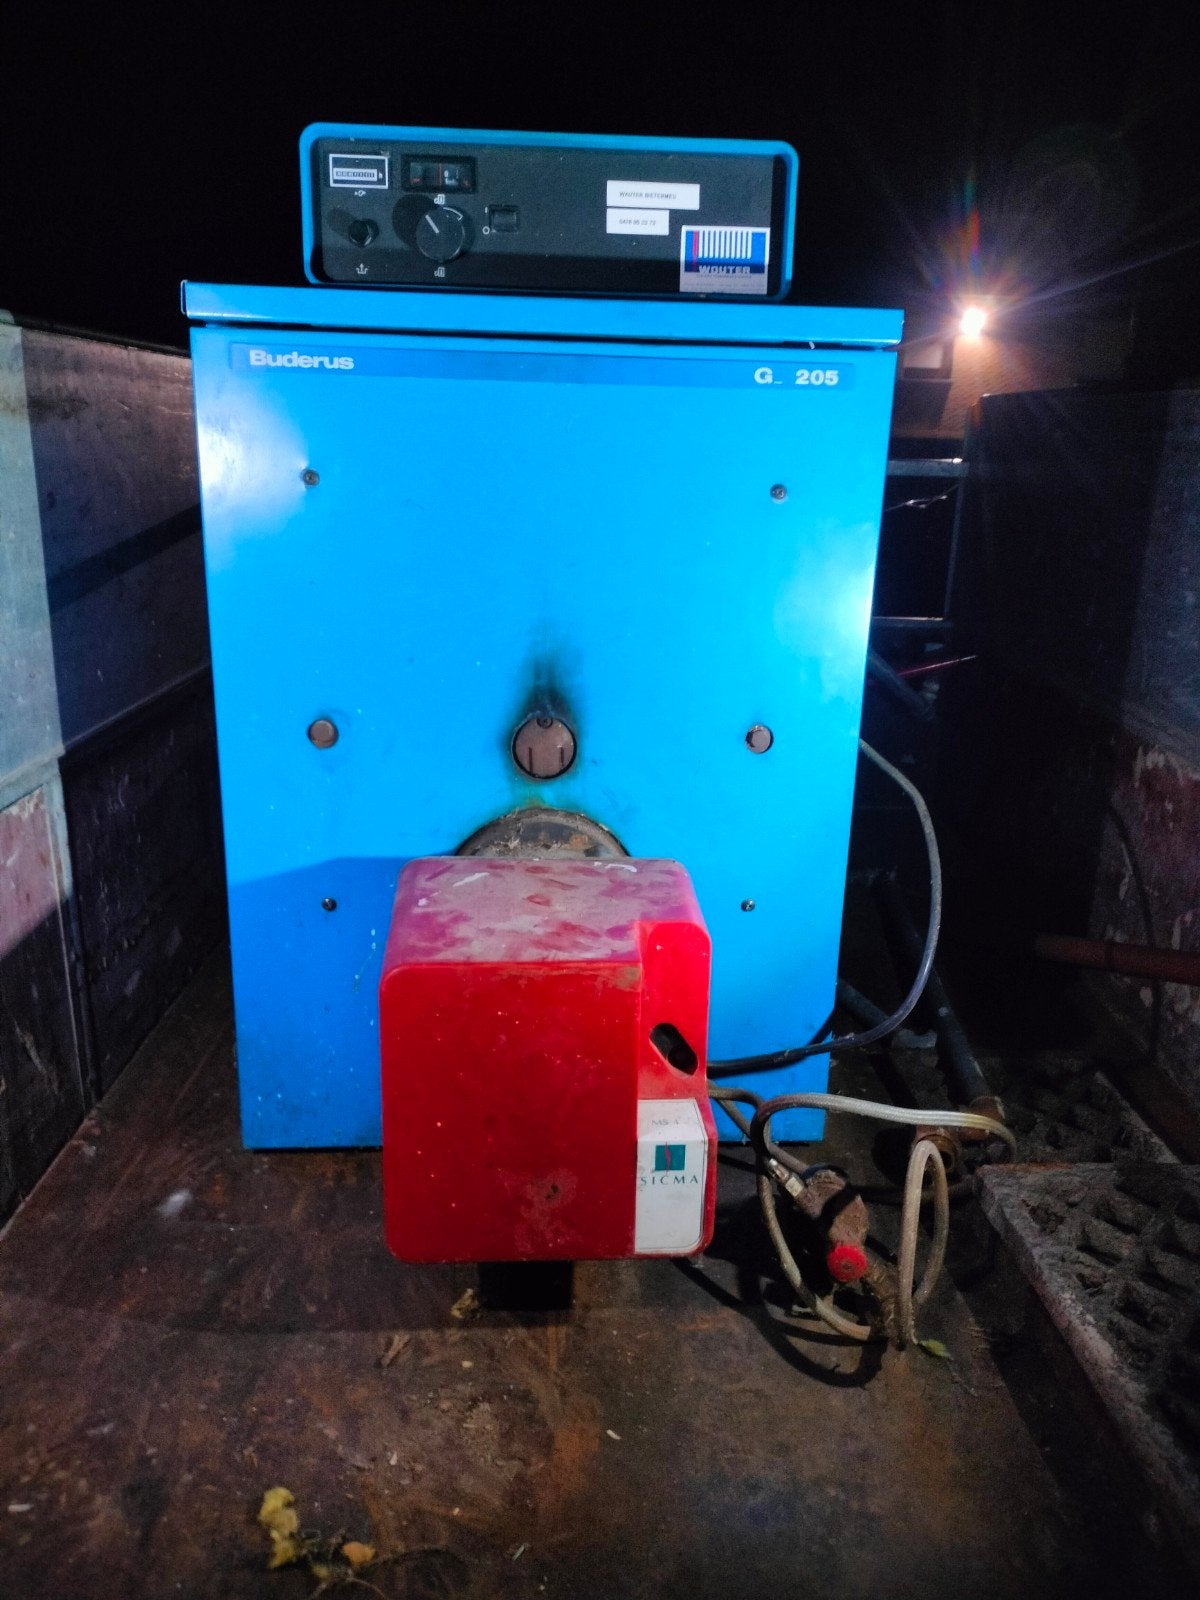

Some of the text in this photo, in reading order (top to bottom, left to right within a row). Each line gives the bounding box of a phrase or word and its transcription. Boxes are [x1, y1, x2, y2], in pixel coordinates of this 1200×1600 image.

[249, 349, 355, 370] Buderus
[794, 368, 840, 386] 205
[640, 1174, 698, 1186] SICMA
